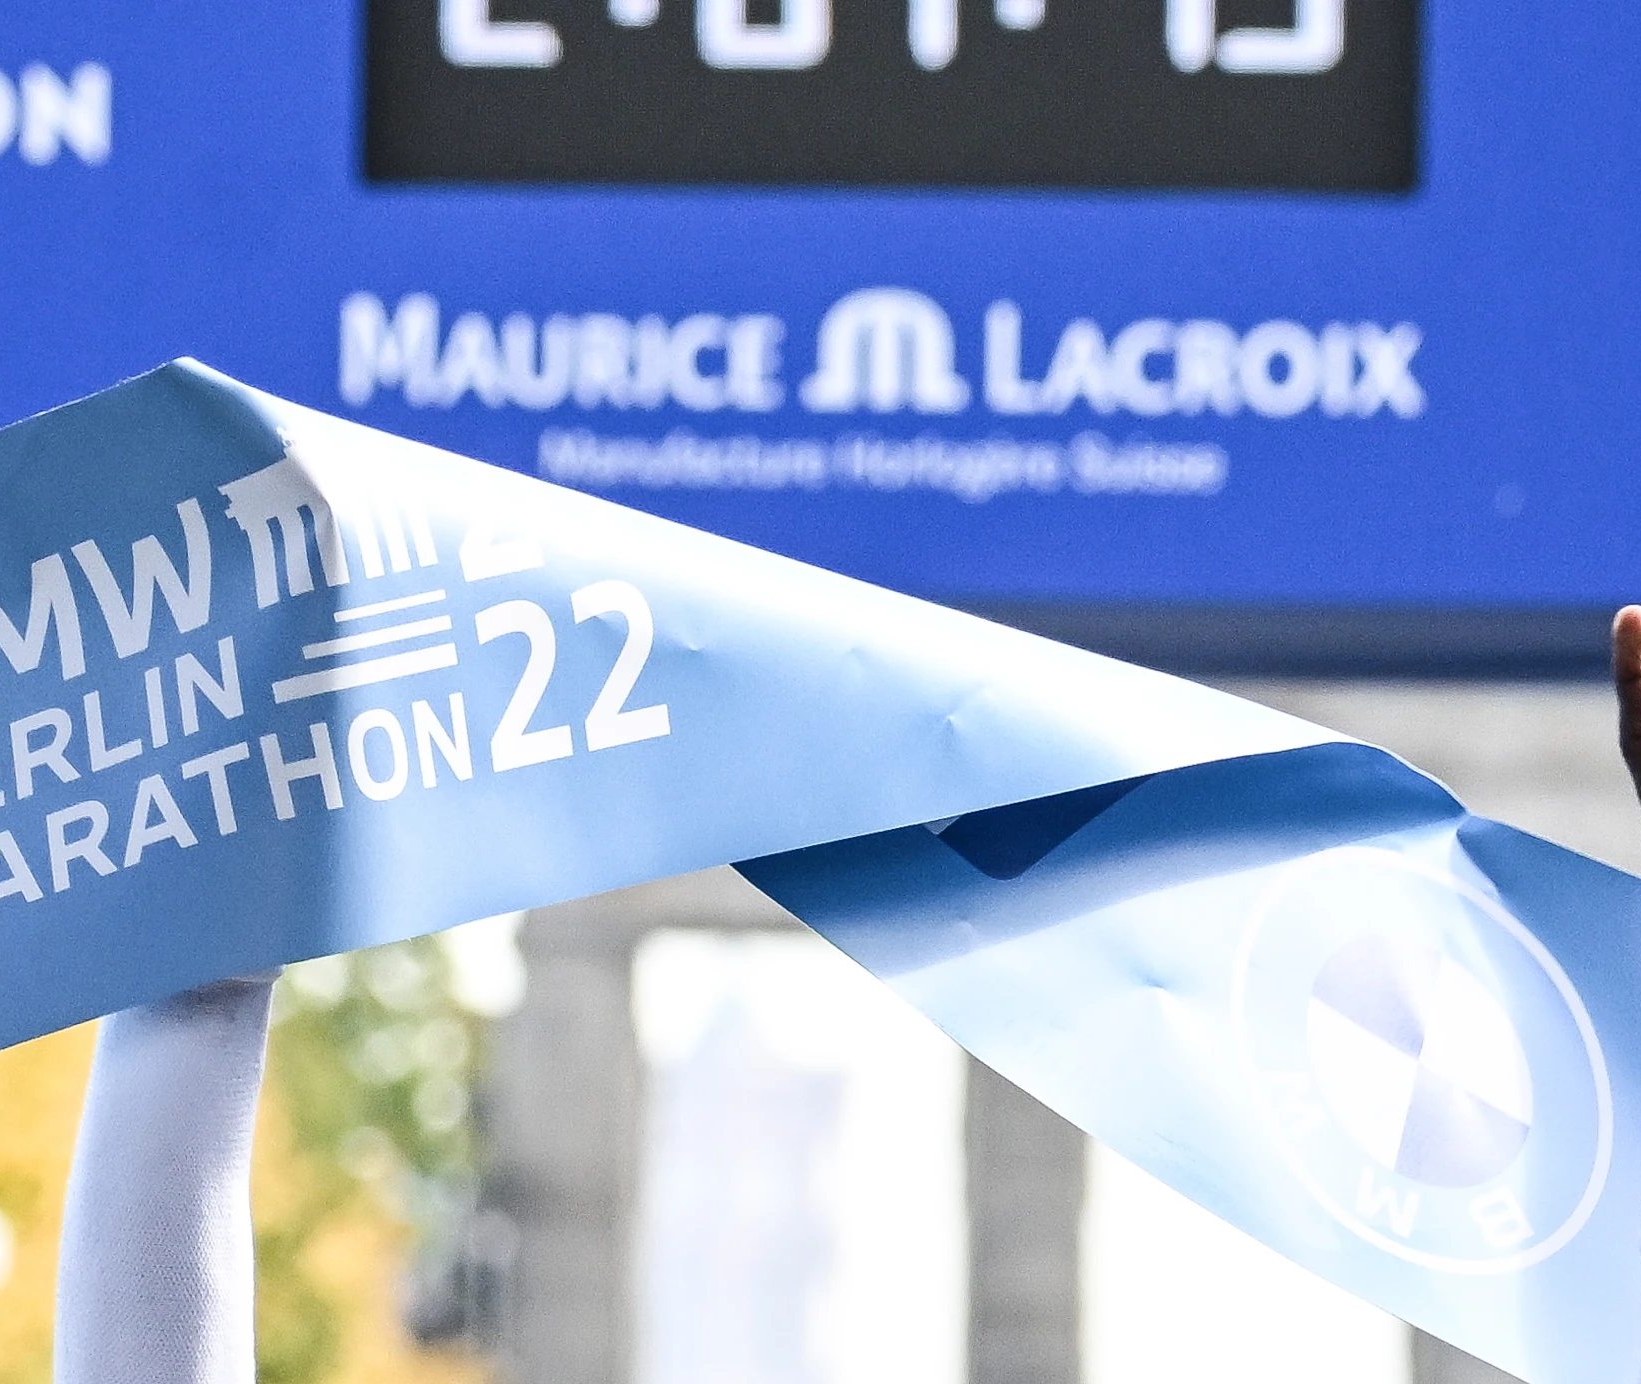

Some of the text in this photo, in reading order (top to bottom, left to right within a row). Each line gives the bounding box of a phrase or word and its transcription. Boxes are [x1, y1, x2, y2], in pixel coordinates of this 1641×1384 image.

[340, 291, 1427, 419] MAURICE LACROIX
[475, 579, 671, 773] 22
